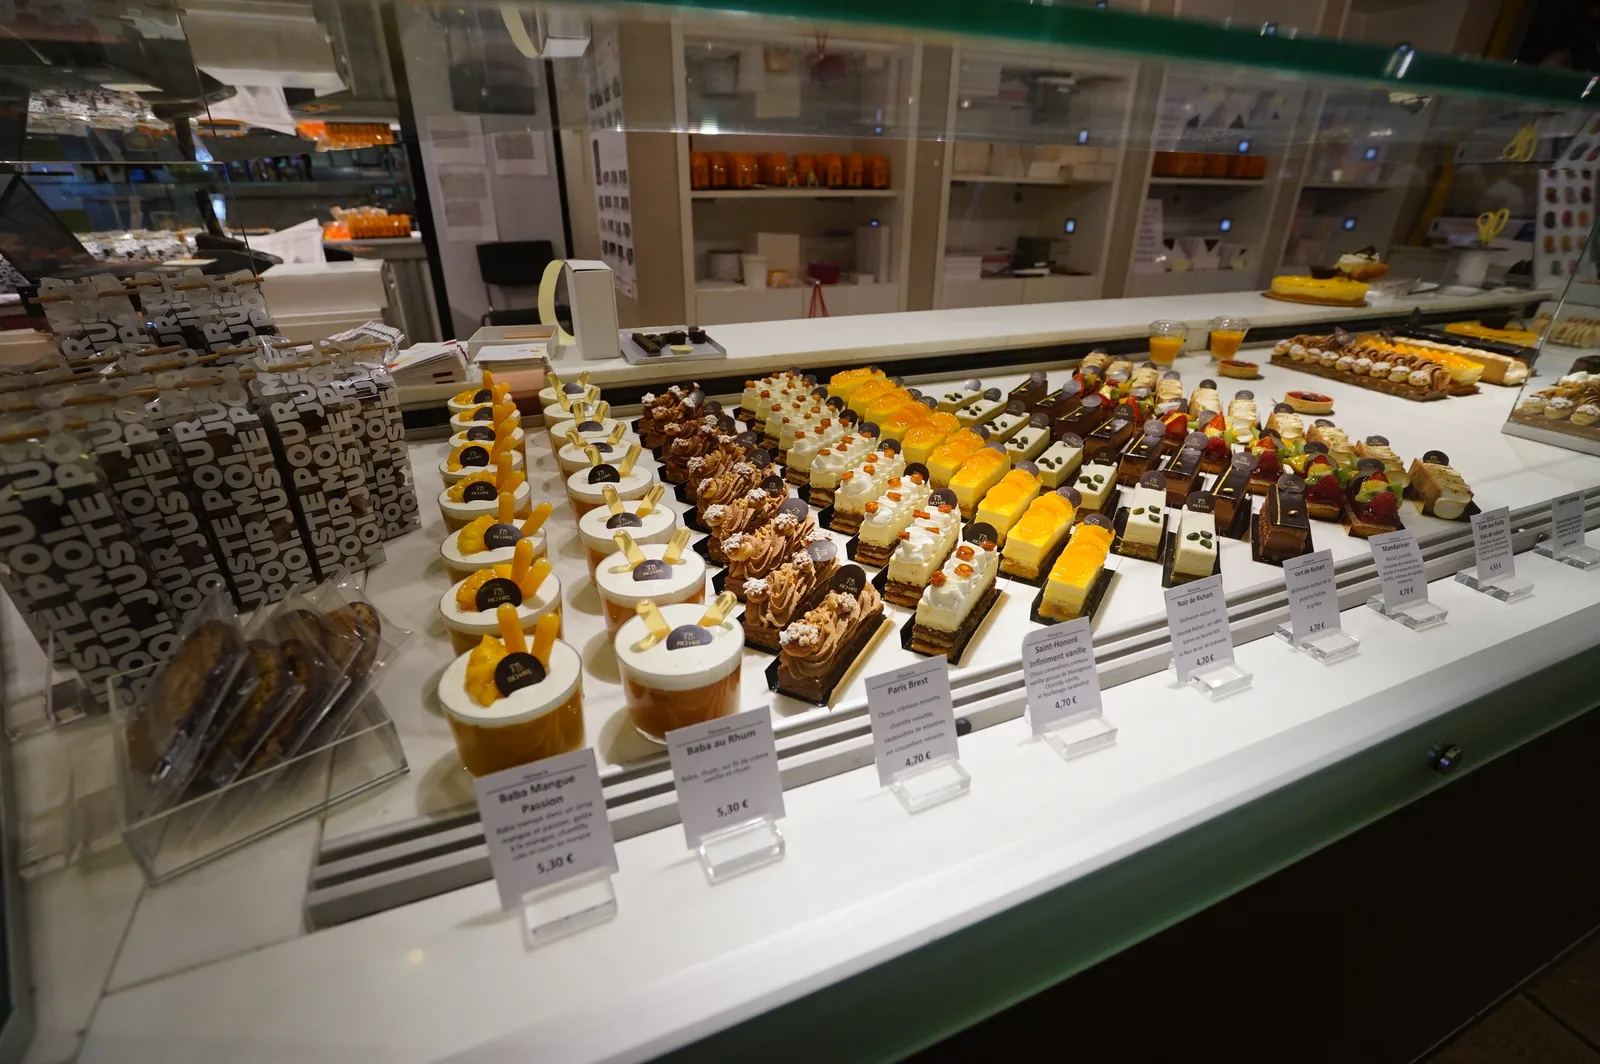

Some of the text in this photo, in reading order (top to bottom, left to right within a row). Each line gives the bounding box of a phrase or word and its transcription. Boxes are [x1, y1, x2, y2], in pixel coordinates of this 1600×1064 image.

[173, 420, 234, 512] POUR
[270, 400, 321, 488] POUR
[310, 426, 345, 492] MOI.
[326, 410, 370, 502] JUSTE
[114, 467, 172, 542] MOI.
[135, 448, 208, 548] JUSTE
[217, 442, 264, 516] MOI.
[238, 428, 295, 523] JUSTE
[41, 515, 115, 602] MOI.
[67, 492, 160, 606] JUSTE
[211, 515, 269, 604] JUSTE
[245, 519, 291, 602] POUR
[278, 529, 318, 594] MOI.
[300, 491, 346, 576] JUSTE
[327, 496, 367, 574] POUR
[356, 506, 387, 566] MOI.
[1382, 541, 1410, 552] Mandarinier
[150, 545, 202, 610] OUR
[1310, 564, 1325, 573] Richart
[1400, 587, 1410, 597] 4,70
[1177, 599, 1189, 608] Noir
[1196, 591, 1214, 602] Richart
[1309, 623, 1321, 633] 4,70
[1029, 646, 1087, 668] Infiniment vanille
[1035, 636, 1079, 654] Saint-Honoré
[1196, 655, 1209, 667] 4,70
[888, 677, 928, 696] Paris Brest
[1055, 698, 1071, 710] 4,70
[686, 743, 712, 756] Baba
[714, 739, 726, 749] au
[728, 730, 756, 744] Rhum
[905, 753, 924, 767] 4,70
[499, 775, 576, 804] Baba Mangue
[521, 795, 564, 814] Passion
[717, 799, 749, 818] 5,30 €
[537, 856, 565, 875] 5,30
[566, 852, 575, 865] €
